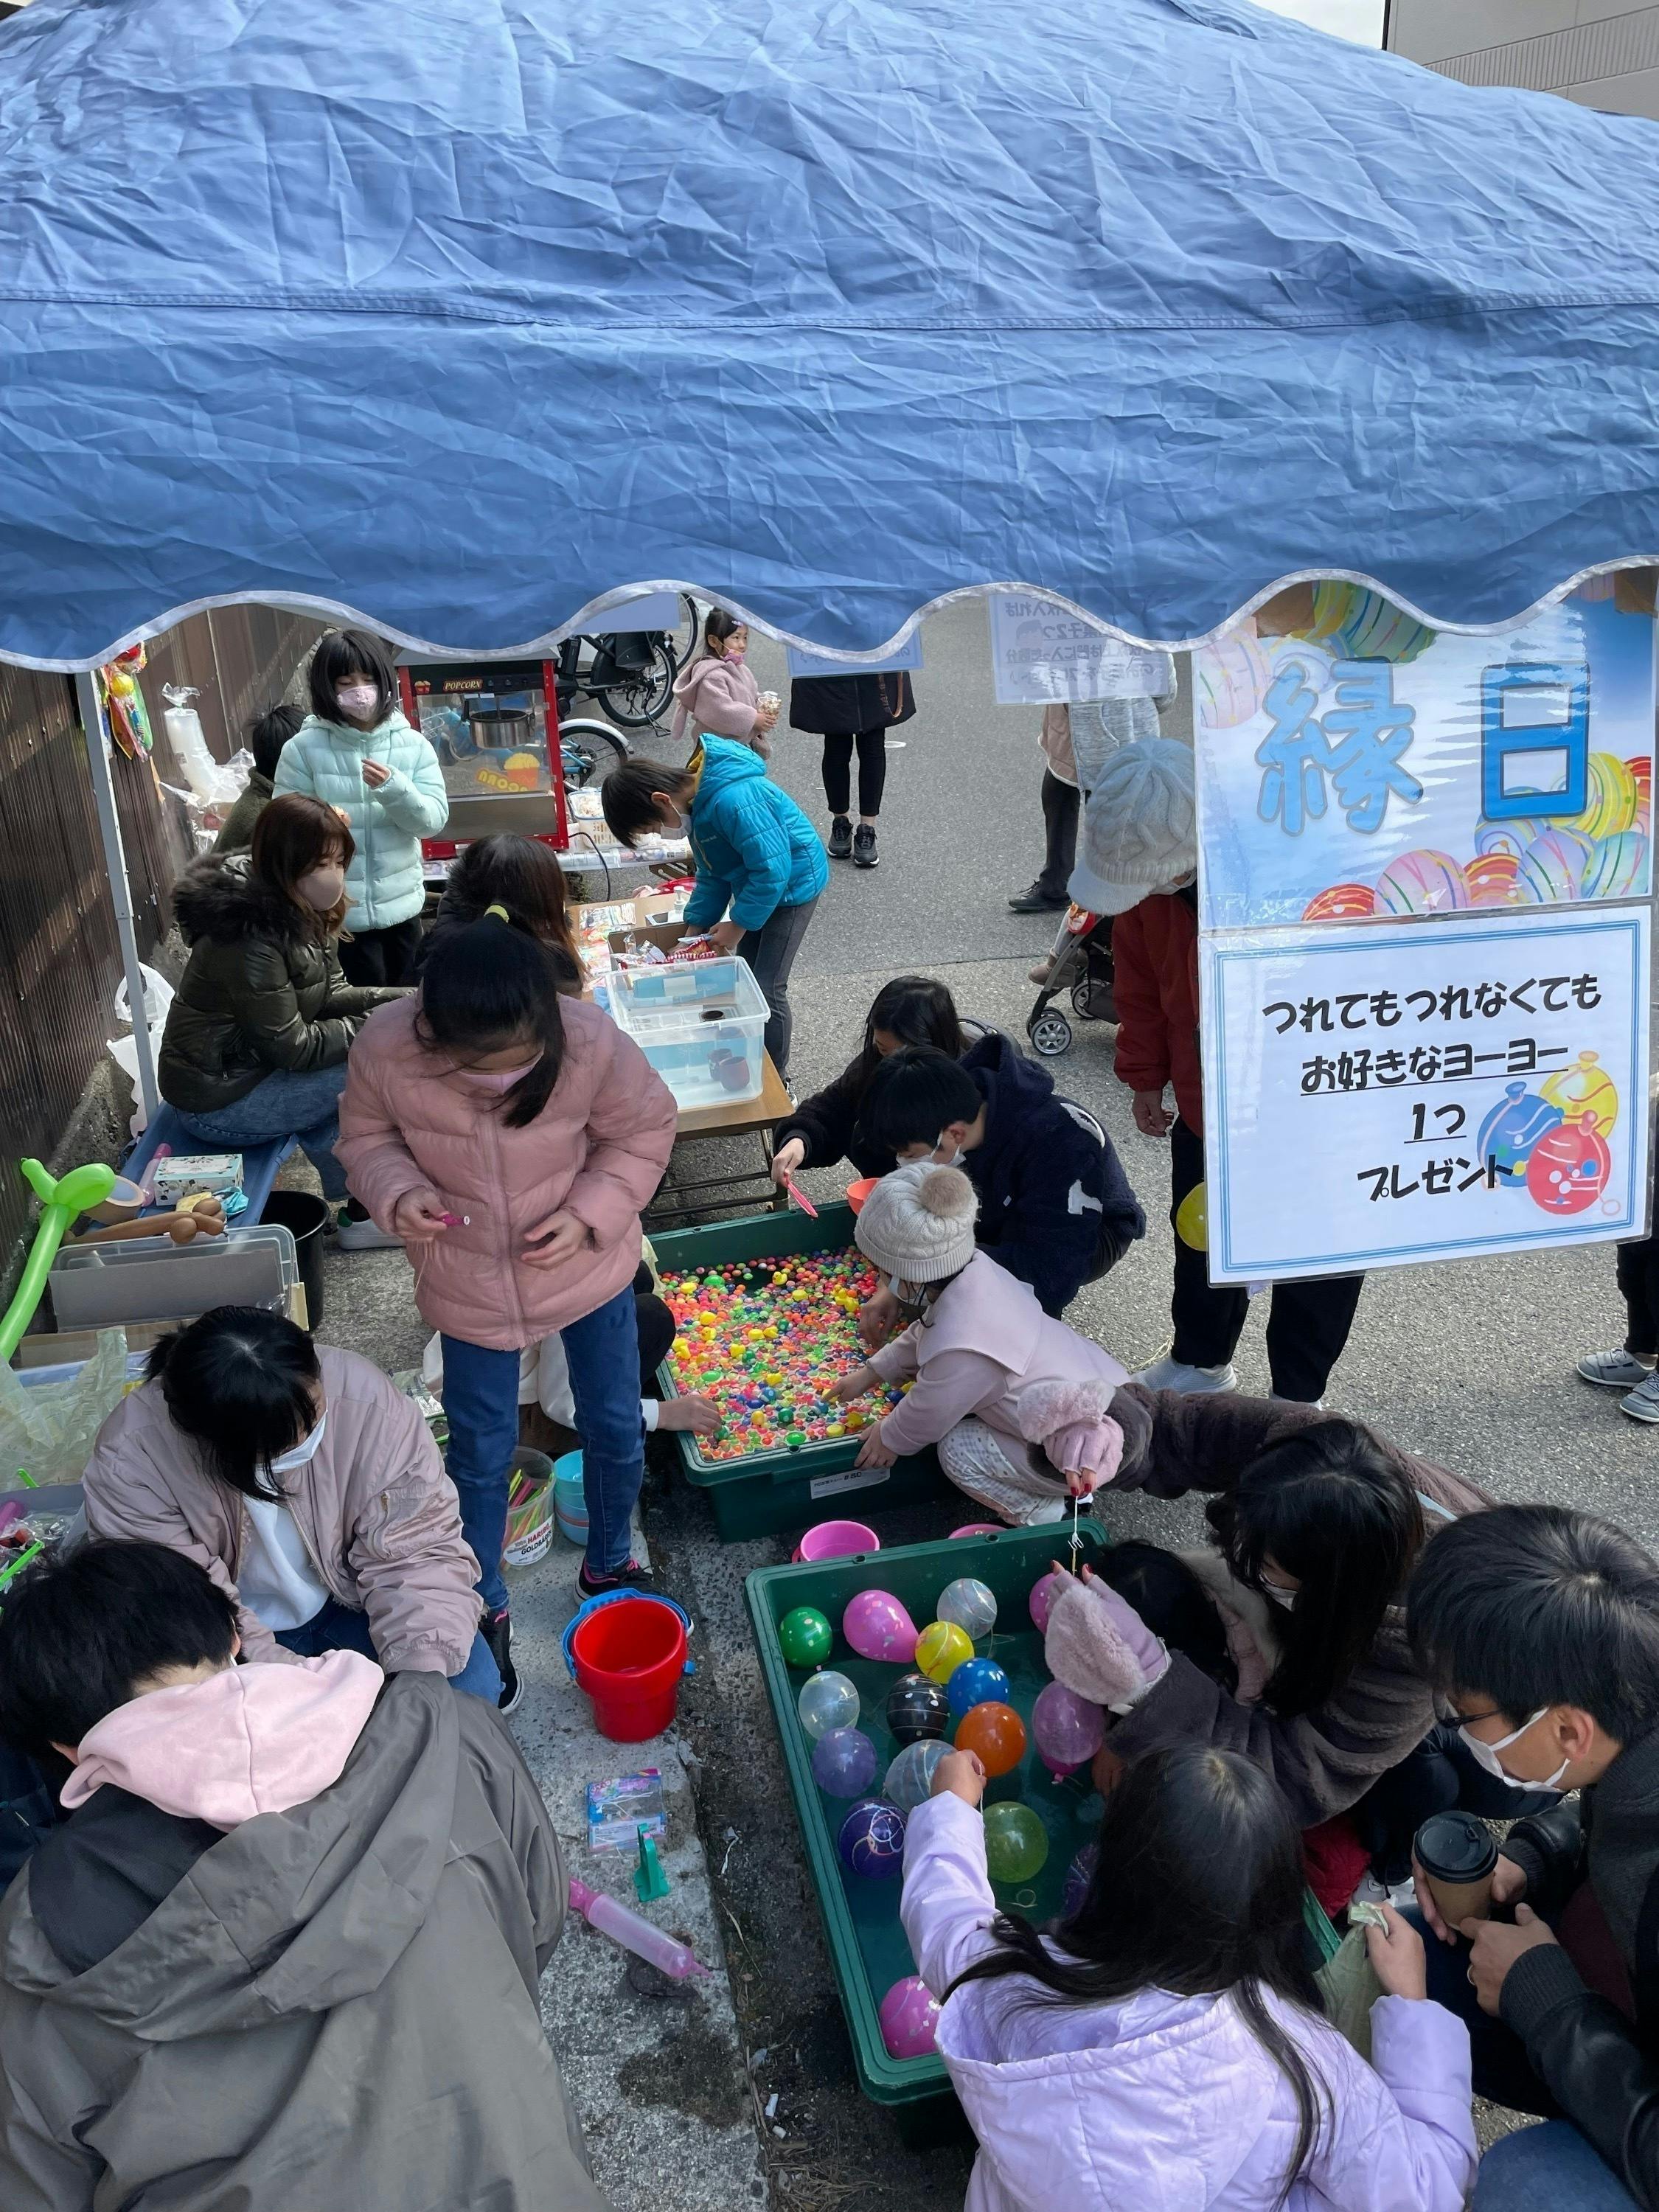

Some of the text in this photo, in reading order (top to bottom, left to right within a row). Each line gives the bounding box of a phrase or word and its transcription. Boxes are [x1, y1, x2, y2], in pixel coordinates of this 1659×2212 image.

[445, 680, 481, 690] POPCORN
[1255, 655, 1590, 836] 縁日
[1262, 973, 1602, 1034] つれてもつれなくても
[1301, 1038, 1568, 1091] お好きなヨーヨー
[1411, 1103, 1467, 1140] 1つ
[1357, 1154, 1514, 1202] プレゼント
